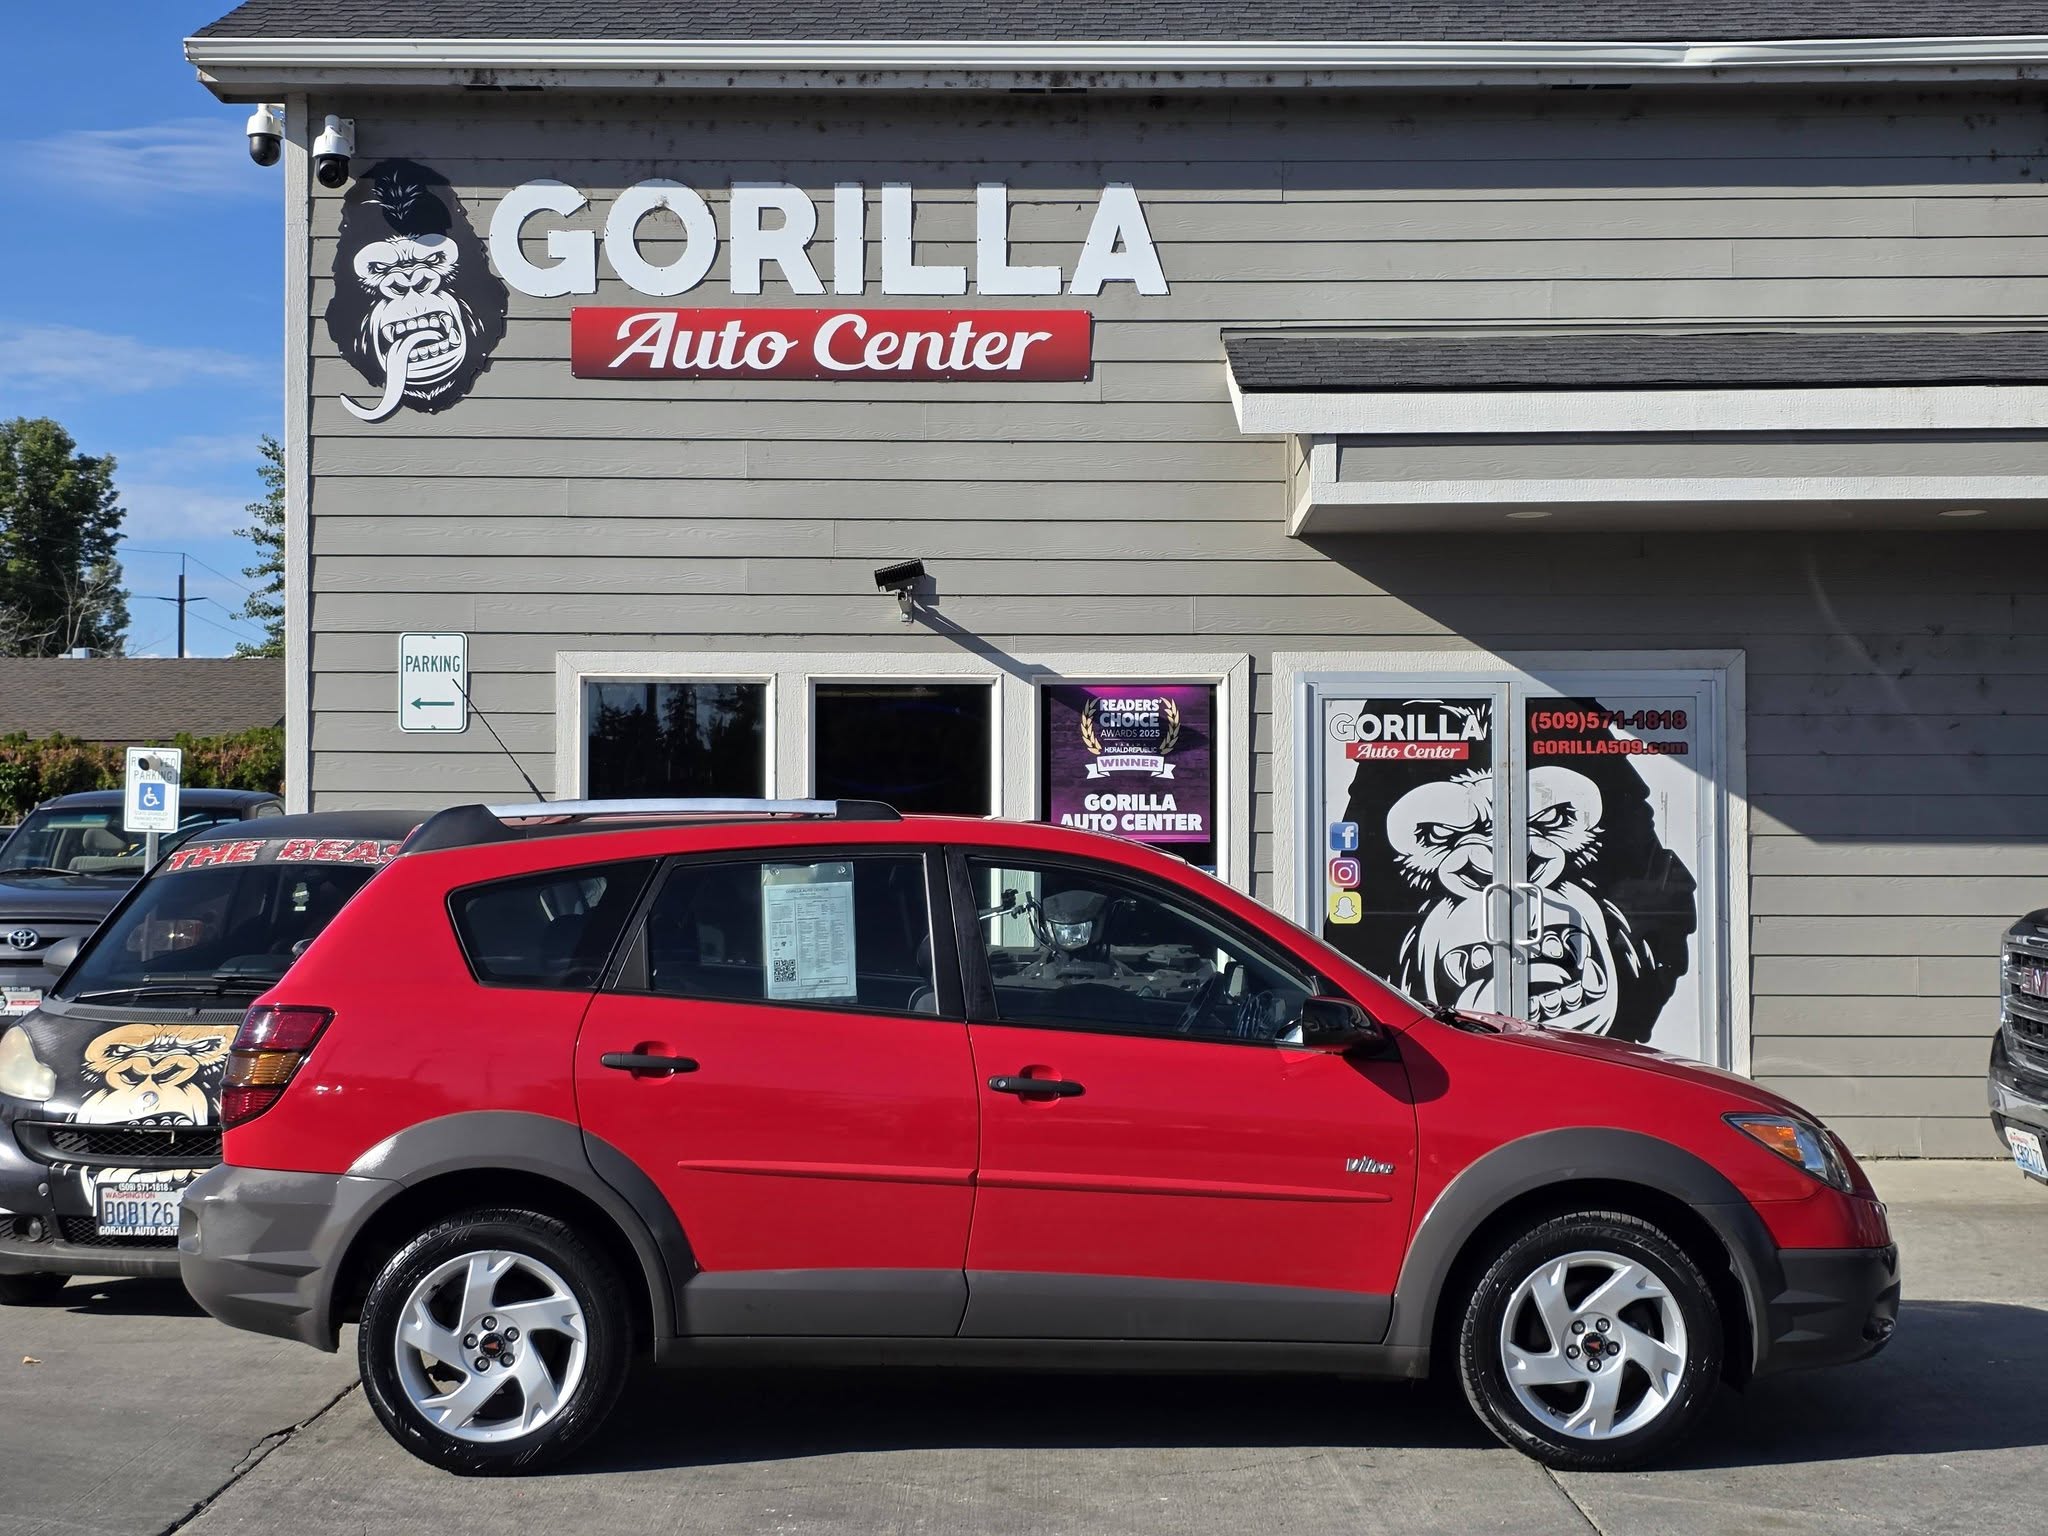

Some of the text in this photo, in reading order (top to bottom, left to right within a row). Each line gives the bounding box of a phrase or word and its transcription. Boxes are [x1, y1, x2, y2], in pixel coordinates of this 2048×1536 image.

[489, 178, 1170, 297] GORILLA
[608, 312, 1052, 372] Auto Center
[405, 655, 461, 673] PARKING
[1099, 698, 1162, 711] READERS'
[1099, 712, 1160, 728] CHOICE
[1329, 713, 1486, 742] GORILLA
[1531, 710, 1687, 731] (509)571-1818
[1100, 729, 1160, 738] AWARDS 2025
[1355, 743, 1461, 760] Auto Center
[1533, 740, 1689, 756] GORILLA509.com
[131, 757, 177, 767] RVED
[1099, 758, 1159, 768] WINNER
[134, 770, 173, 781] PARKING
[1084, 793, 1177, 812] GORILLA
[1060, 813, 1203, 832] AUTO CENTER
[166, 839, 267, 872] THE
[105, 1191, 156, 1199] WASHINGTON
[118, 1183, 169, 1191] (509) 571-1818
[105, 1201, 180, 1226] BQB126
[134, 1226, 156, 1236] AUTO
